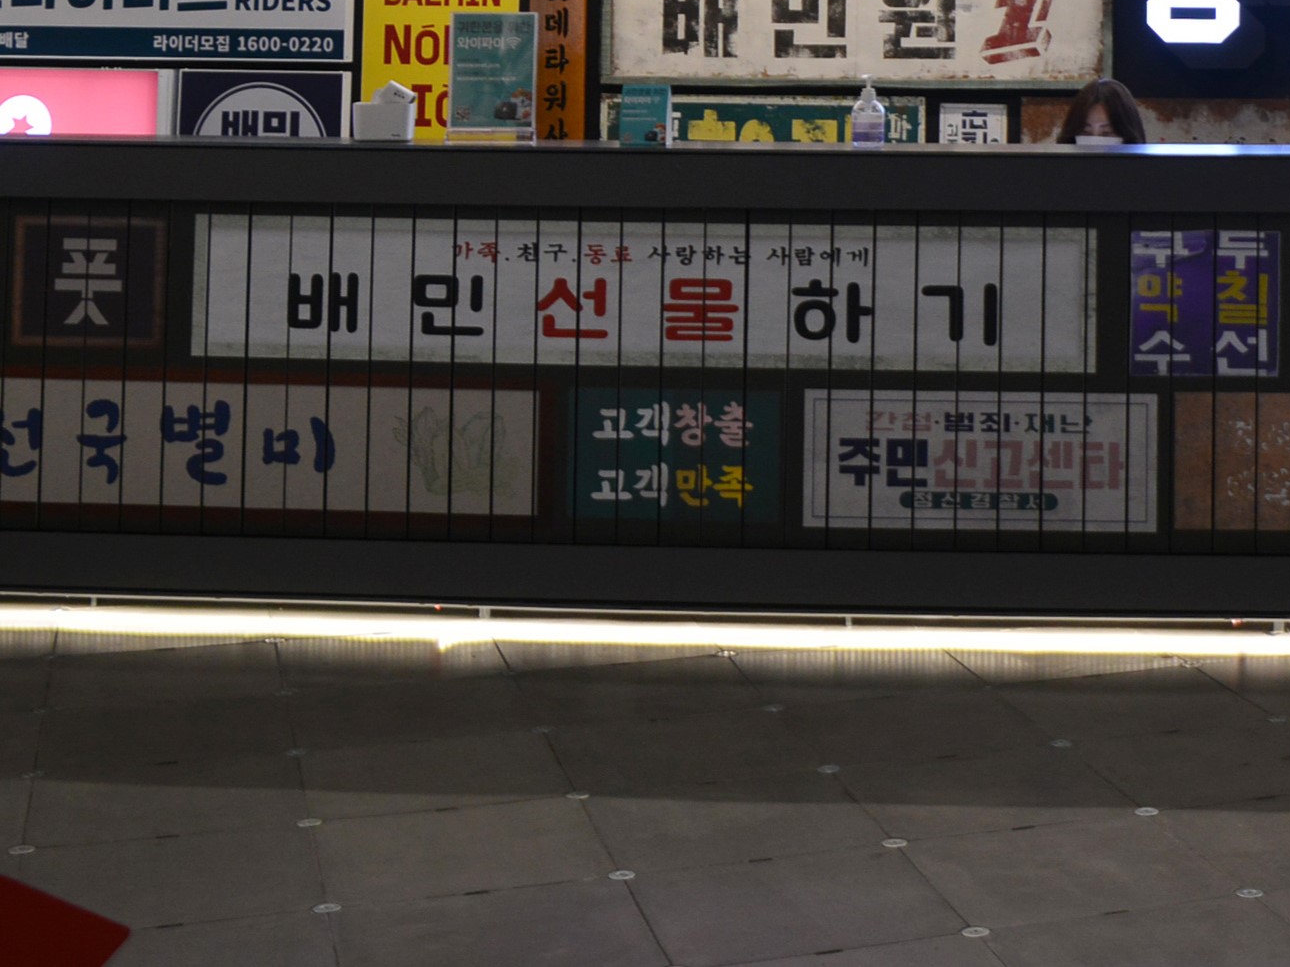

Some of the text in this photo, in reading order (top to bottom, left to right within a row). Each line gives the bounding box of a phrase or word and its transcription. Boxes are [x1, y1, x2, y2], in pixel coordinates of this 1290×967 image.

[153, 35, 230, 53] 라이더모집
[236, 36, 334, 53] 1600-0220
[766, 246, 869, 267] 사람에게
